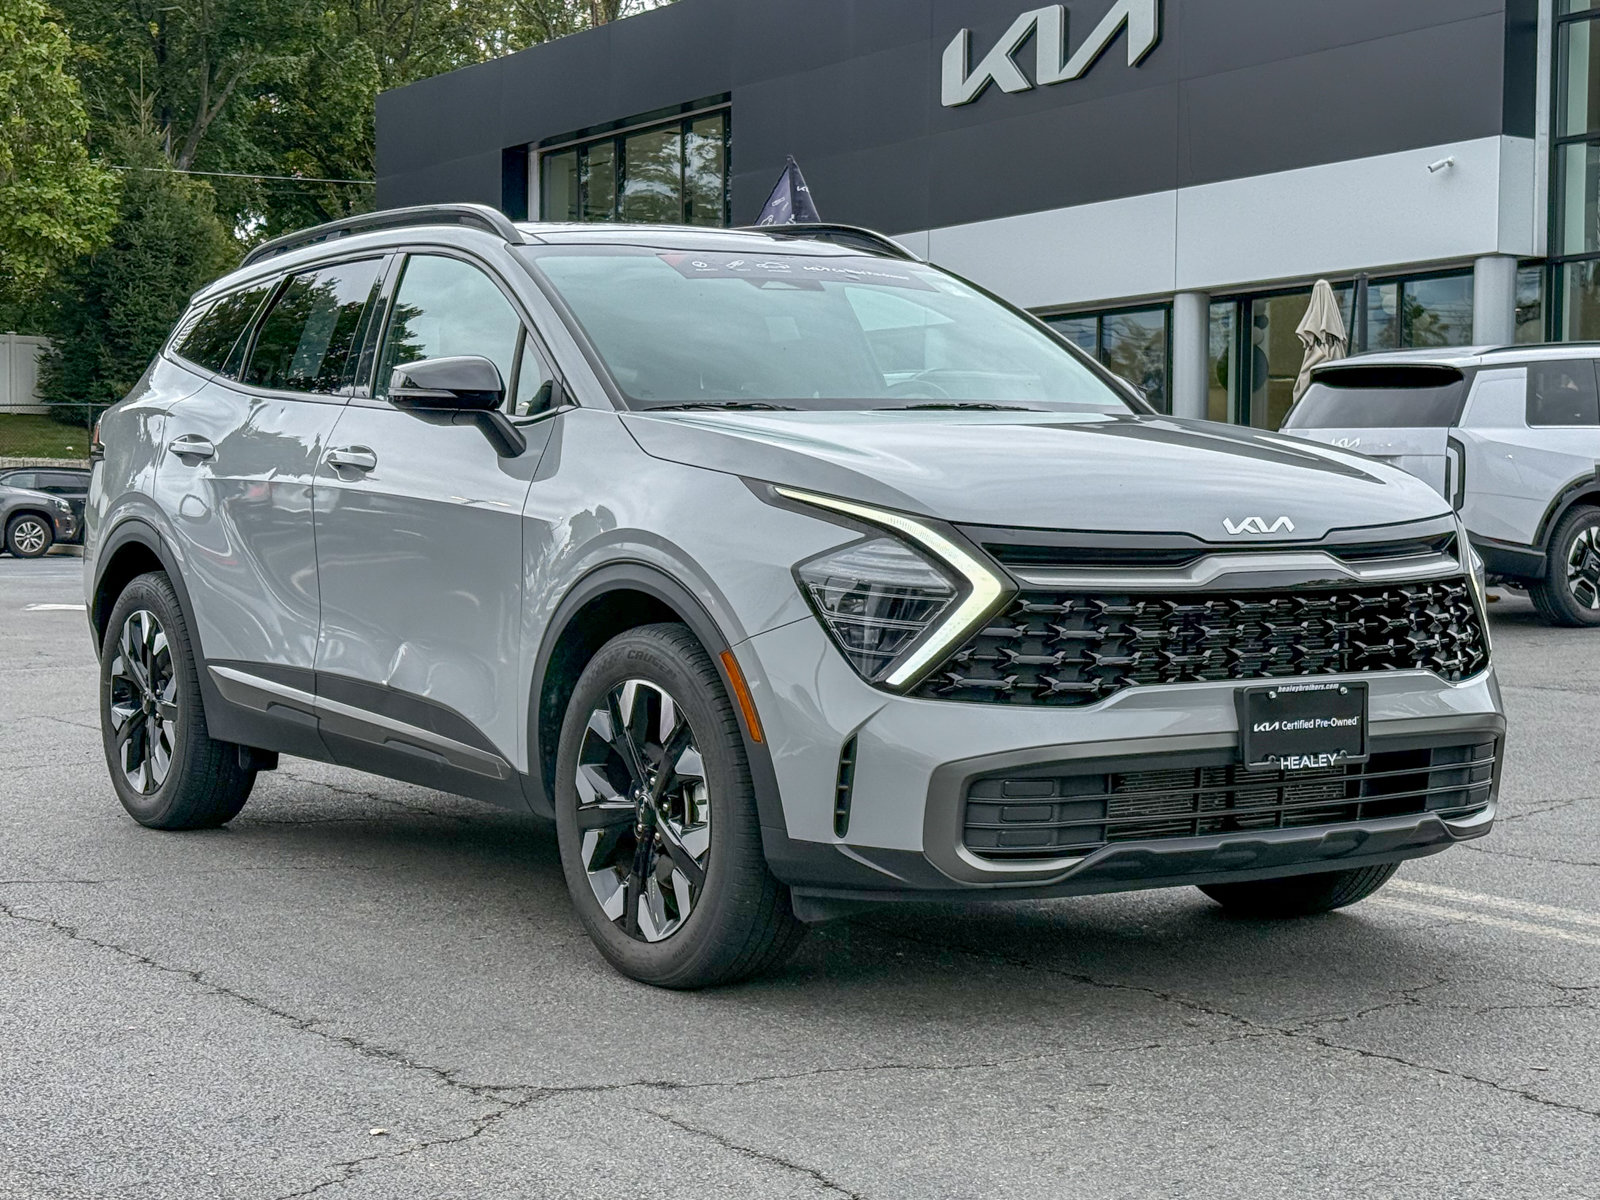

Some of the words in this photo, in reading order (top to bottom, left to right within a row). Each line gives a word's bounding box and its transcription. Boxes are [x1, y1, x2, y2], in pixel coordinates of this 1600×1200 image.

[941, 0, 1158, 107] KIA
[1222, 516, 1295, 535] KIA
[1277, 683, 1339, 693] healeybrothers.com
[1253, 721, 1279, 732] KIA
[1281, 719, 1314, 730] Certified
[1280, 753, 1337, 770] HEALEY
